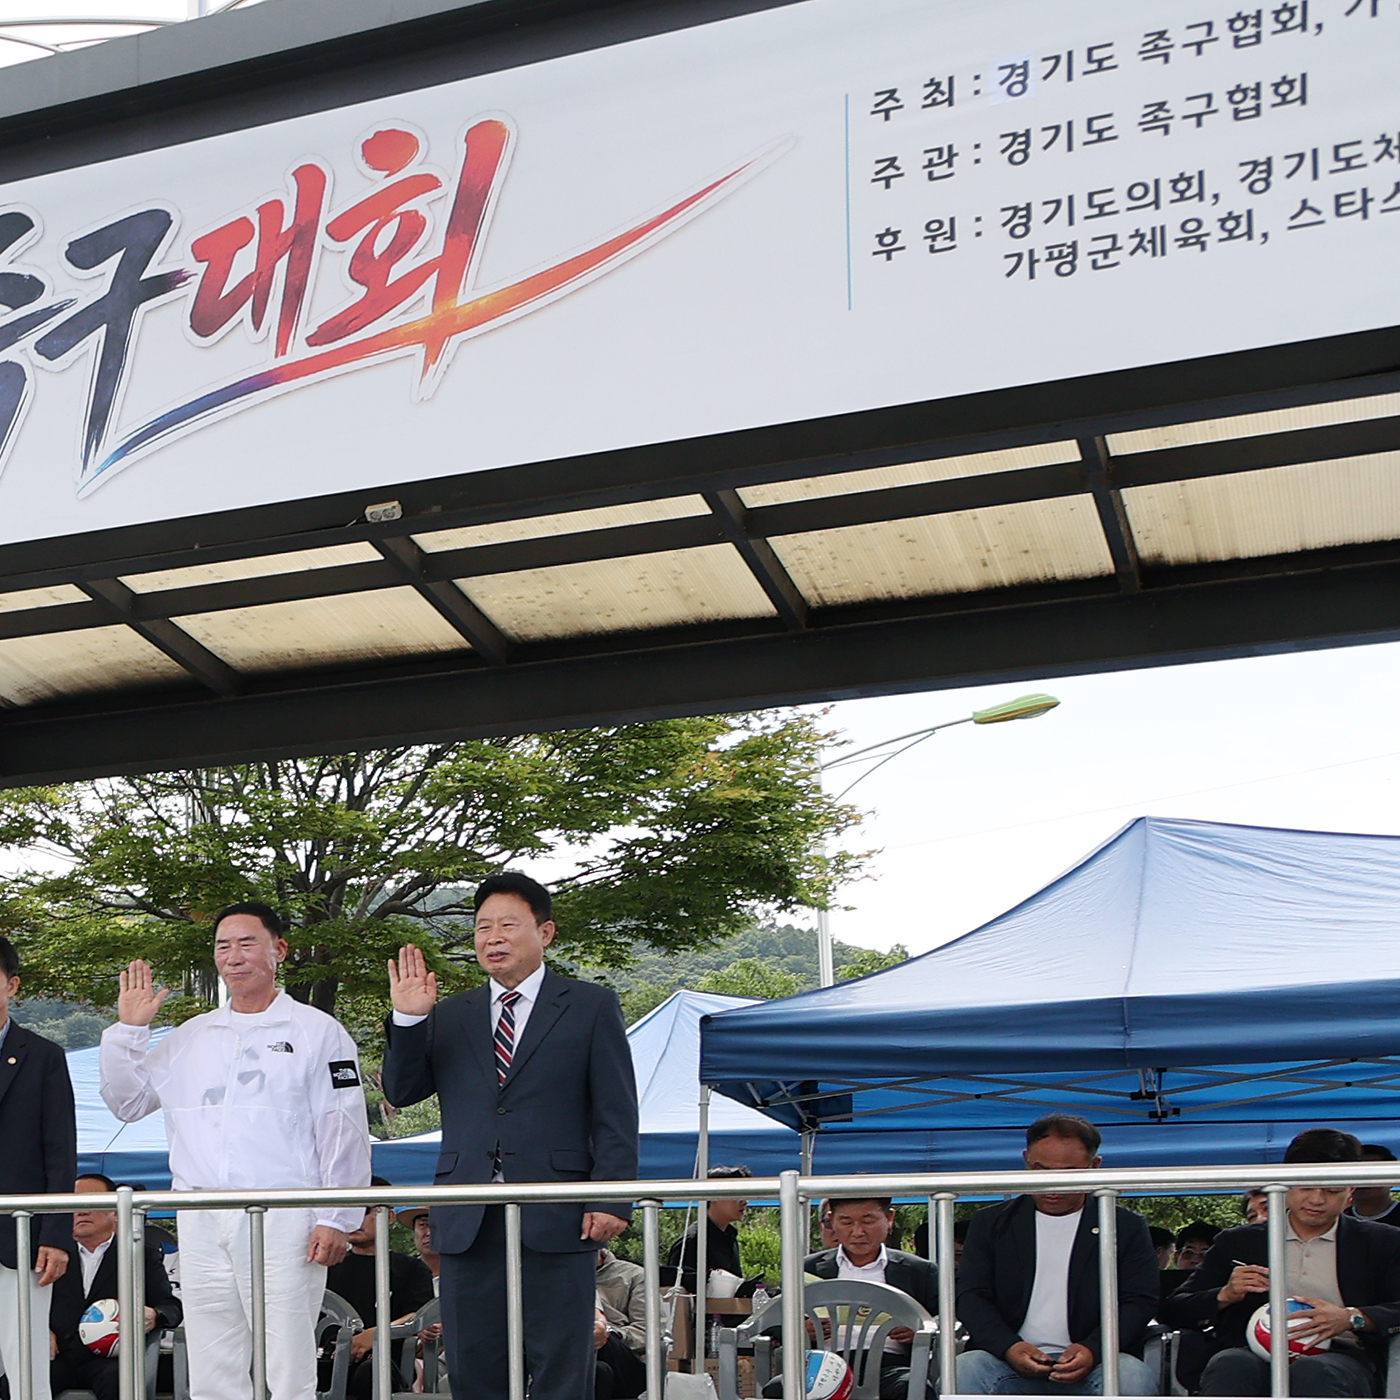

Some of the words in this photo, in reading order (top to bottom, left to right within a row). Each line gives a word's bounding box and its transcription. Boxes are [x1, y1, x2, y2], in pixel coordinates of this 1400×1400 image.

[997, 41, 1118, 98] 경기도
[1137, 0, 1324, 65] 족구협회,
[999, 113, 1118, 167] 경기도
[1137, 72, 1308, 137] 족구협회
[999, 169, 1220, 240] 경기도의회,
[1003, 208, 1270, 281] 가평군체육회,
